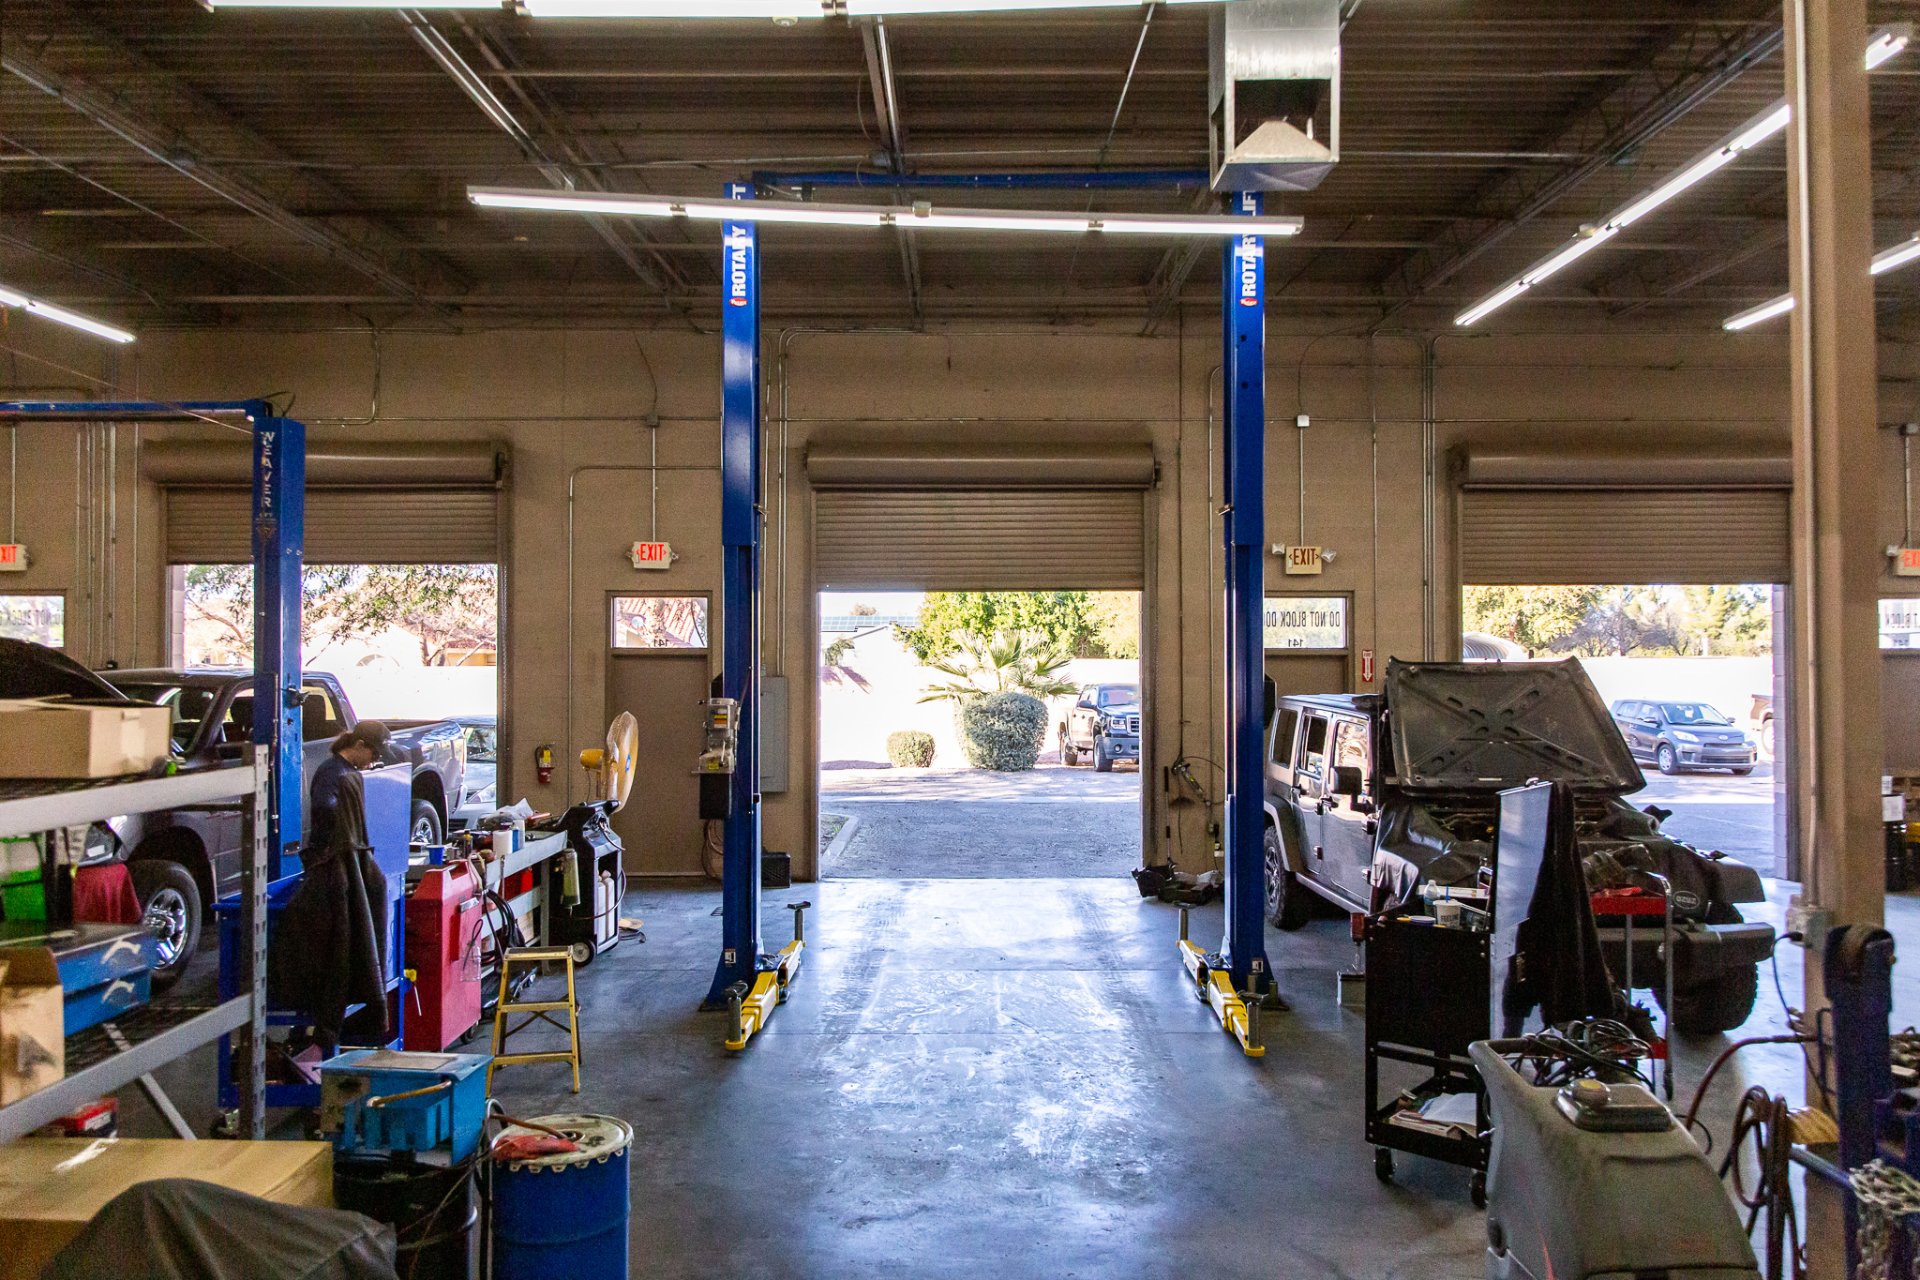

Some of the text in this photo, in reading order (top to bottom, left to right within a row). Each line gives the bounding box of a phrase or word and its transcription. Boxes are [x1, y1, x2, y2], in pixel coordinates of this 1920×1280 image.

[732, 225, 746, 296] ROTARY
[260, 431, 275, 508] WEAVER
[640, 543, 664, 561] EXIT
[1293, 548, 1316, 565] EXIT
